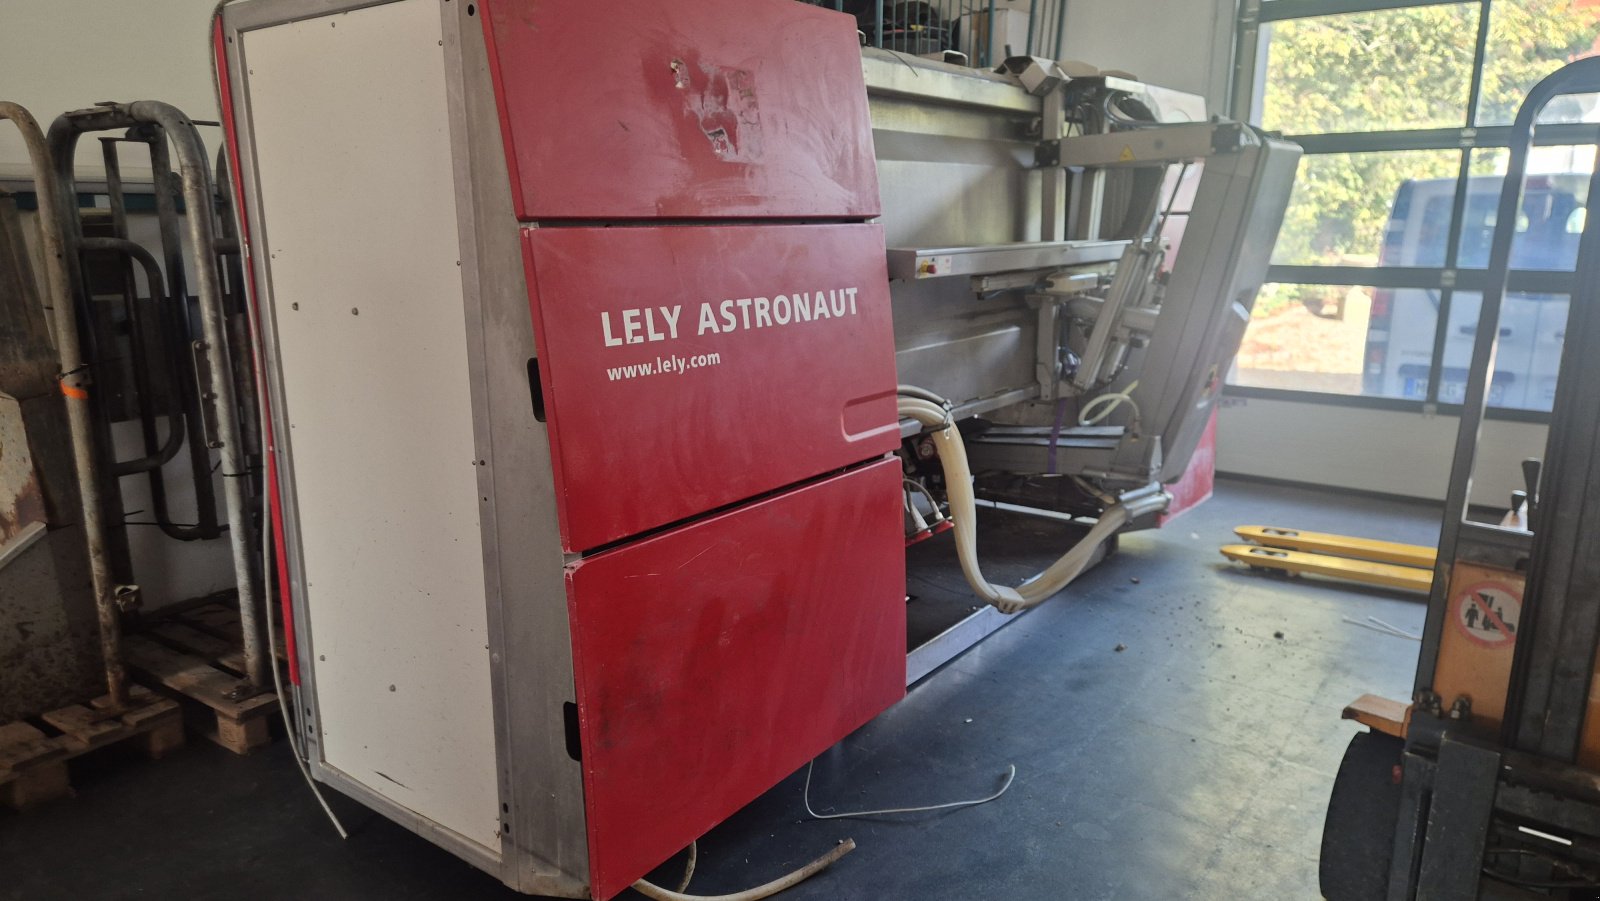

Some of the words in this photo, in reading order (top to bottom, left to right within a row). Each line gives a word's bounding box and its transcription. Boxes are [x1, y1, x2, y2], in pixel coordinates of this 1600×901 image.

[601, 305, 682, 347] LELY
[697, 287, 858, 336] ASTRONAUT
[607, 351, 721, 381] www.lely.com
